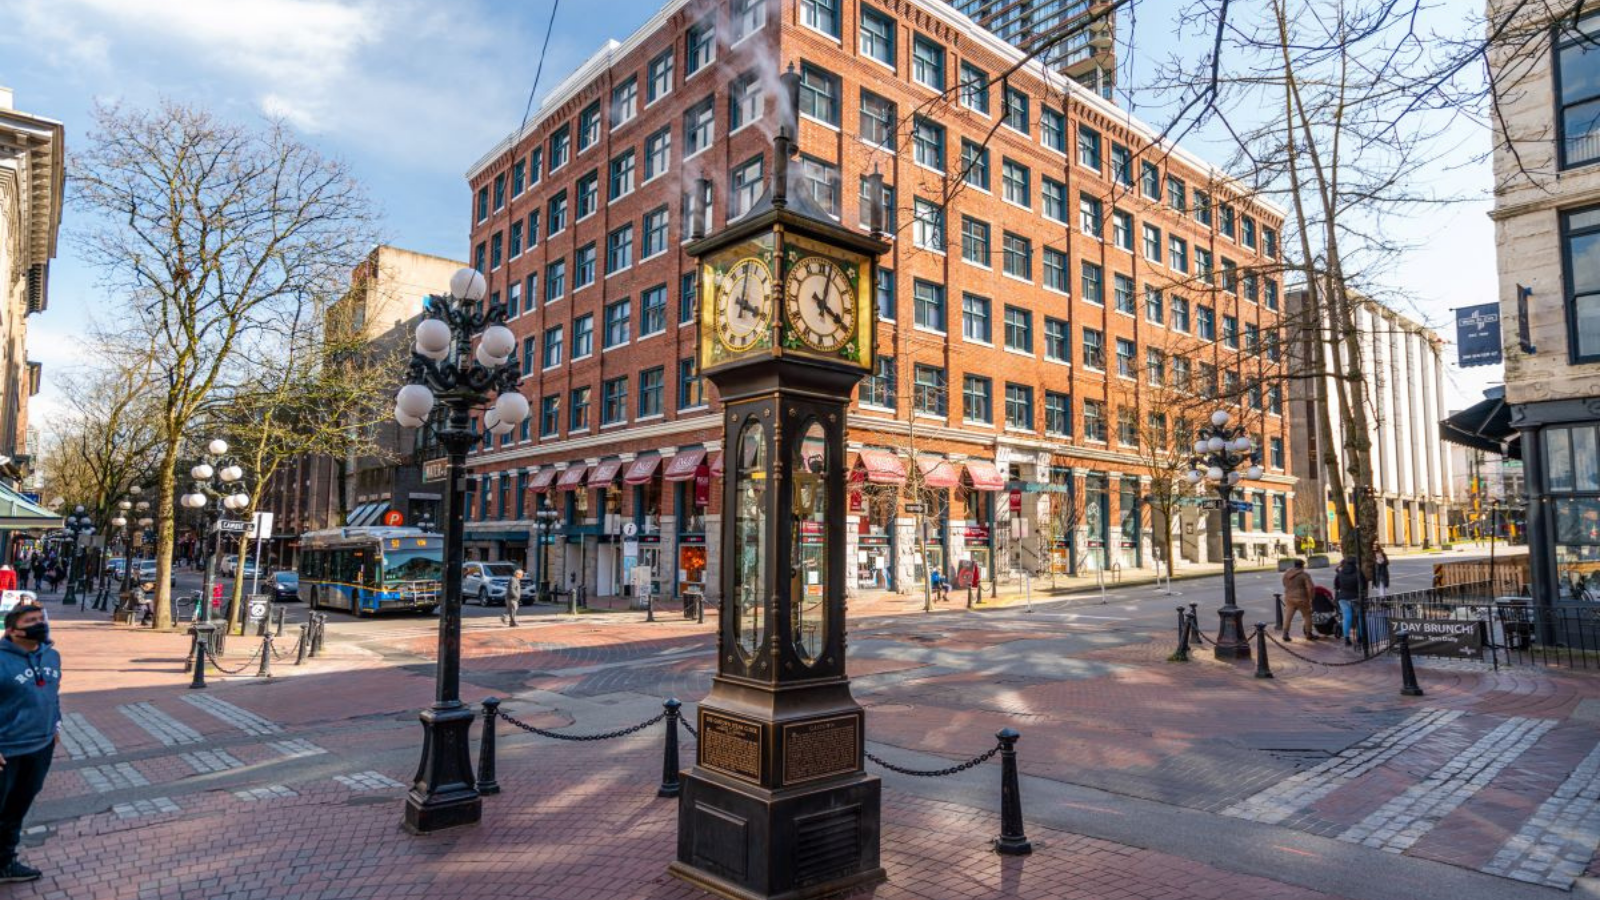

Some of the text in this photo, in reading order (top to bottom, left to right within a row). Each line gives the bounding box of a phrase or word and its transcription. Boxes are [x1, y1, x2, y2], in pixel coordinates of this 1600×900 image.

[388, 513, 400, 526] P
[1391, 622, 1474, 635] 7 DAY BRUNCH!
